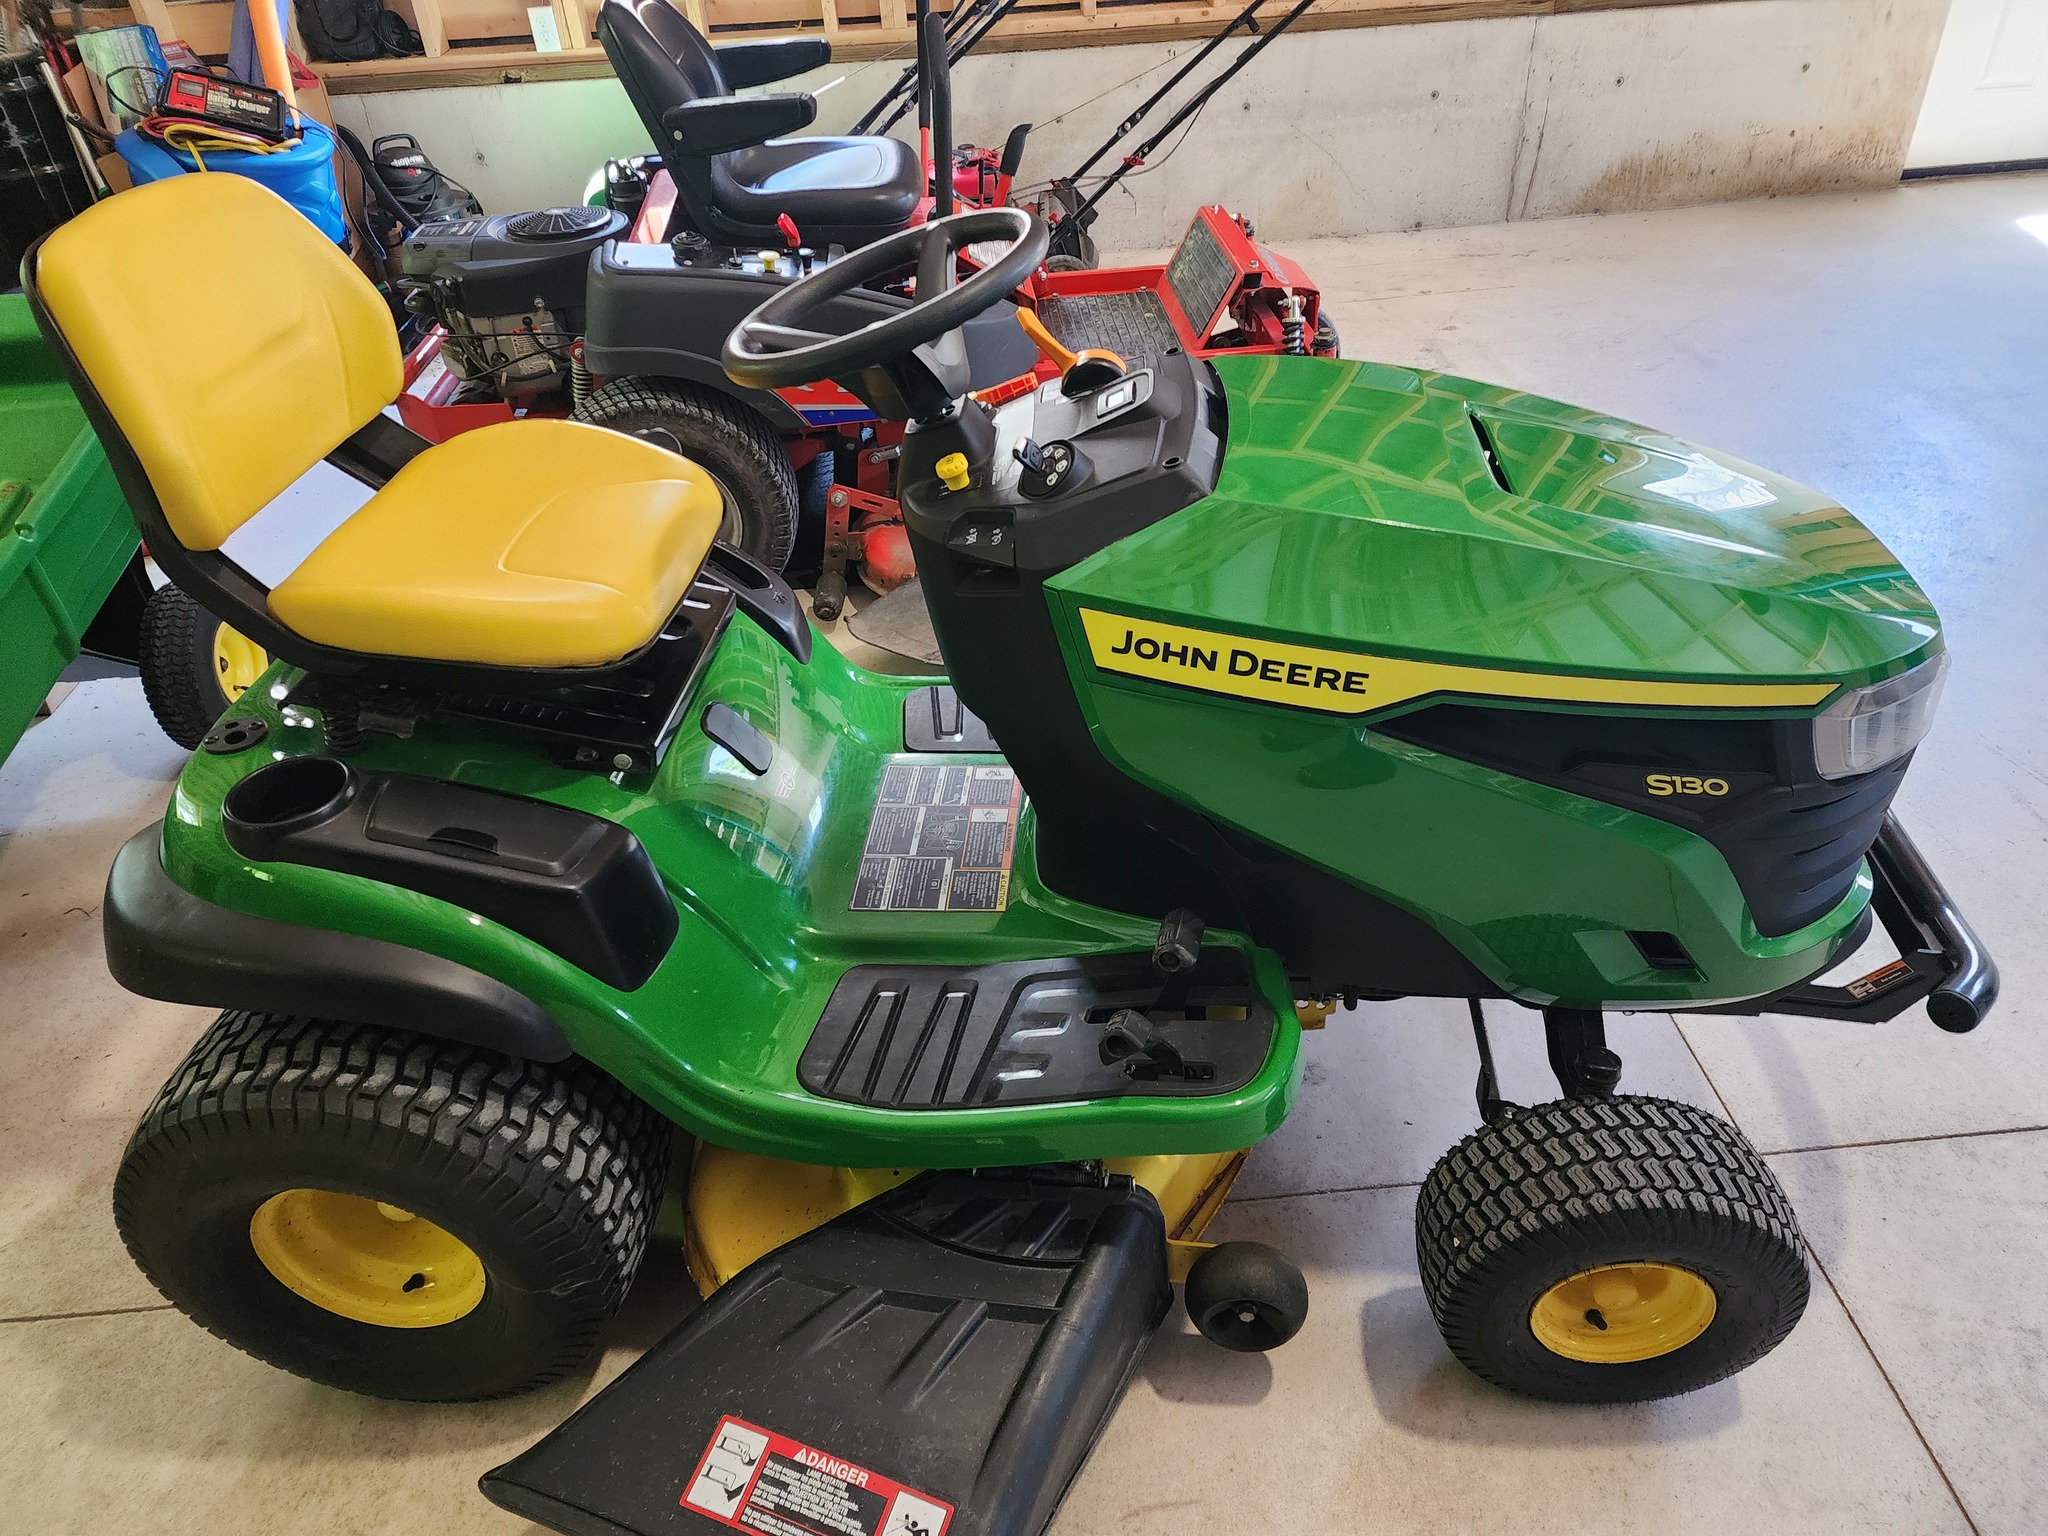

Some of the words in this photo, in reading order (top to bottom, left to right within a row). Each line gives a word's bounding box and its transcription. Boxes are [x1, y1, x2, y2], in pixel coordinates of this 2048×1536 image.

[206, 92, 237, 107] Battery
[237, 98, 271, 115] Charger
[1111, 630, 1218, 671] JOHN
[1228, 649, 1370, 694] DEERE
[1646, 774, 1729, 796] S130
[998, 879, 1007, 906] CAUTION
[803, 1451, 869, 1488] DANGER
[805, 1467, 823, 1480] LAME
[819, 1472, 848, 1491] ROTATIVE
[785, 1483, 821, 1505] PROJECTION
